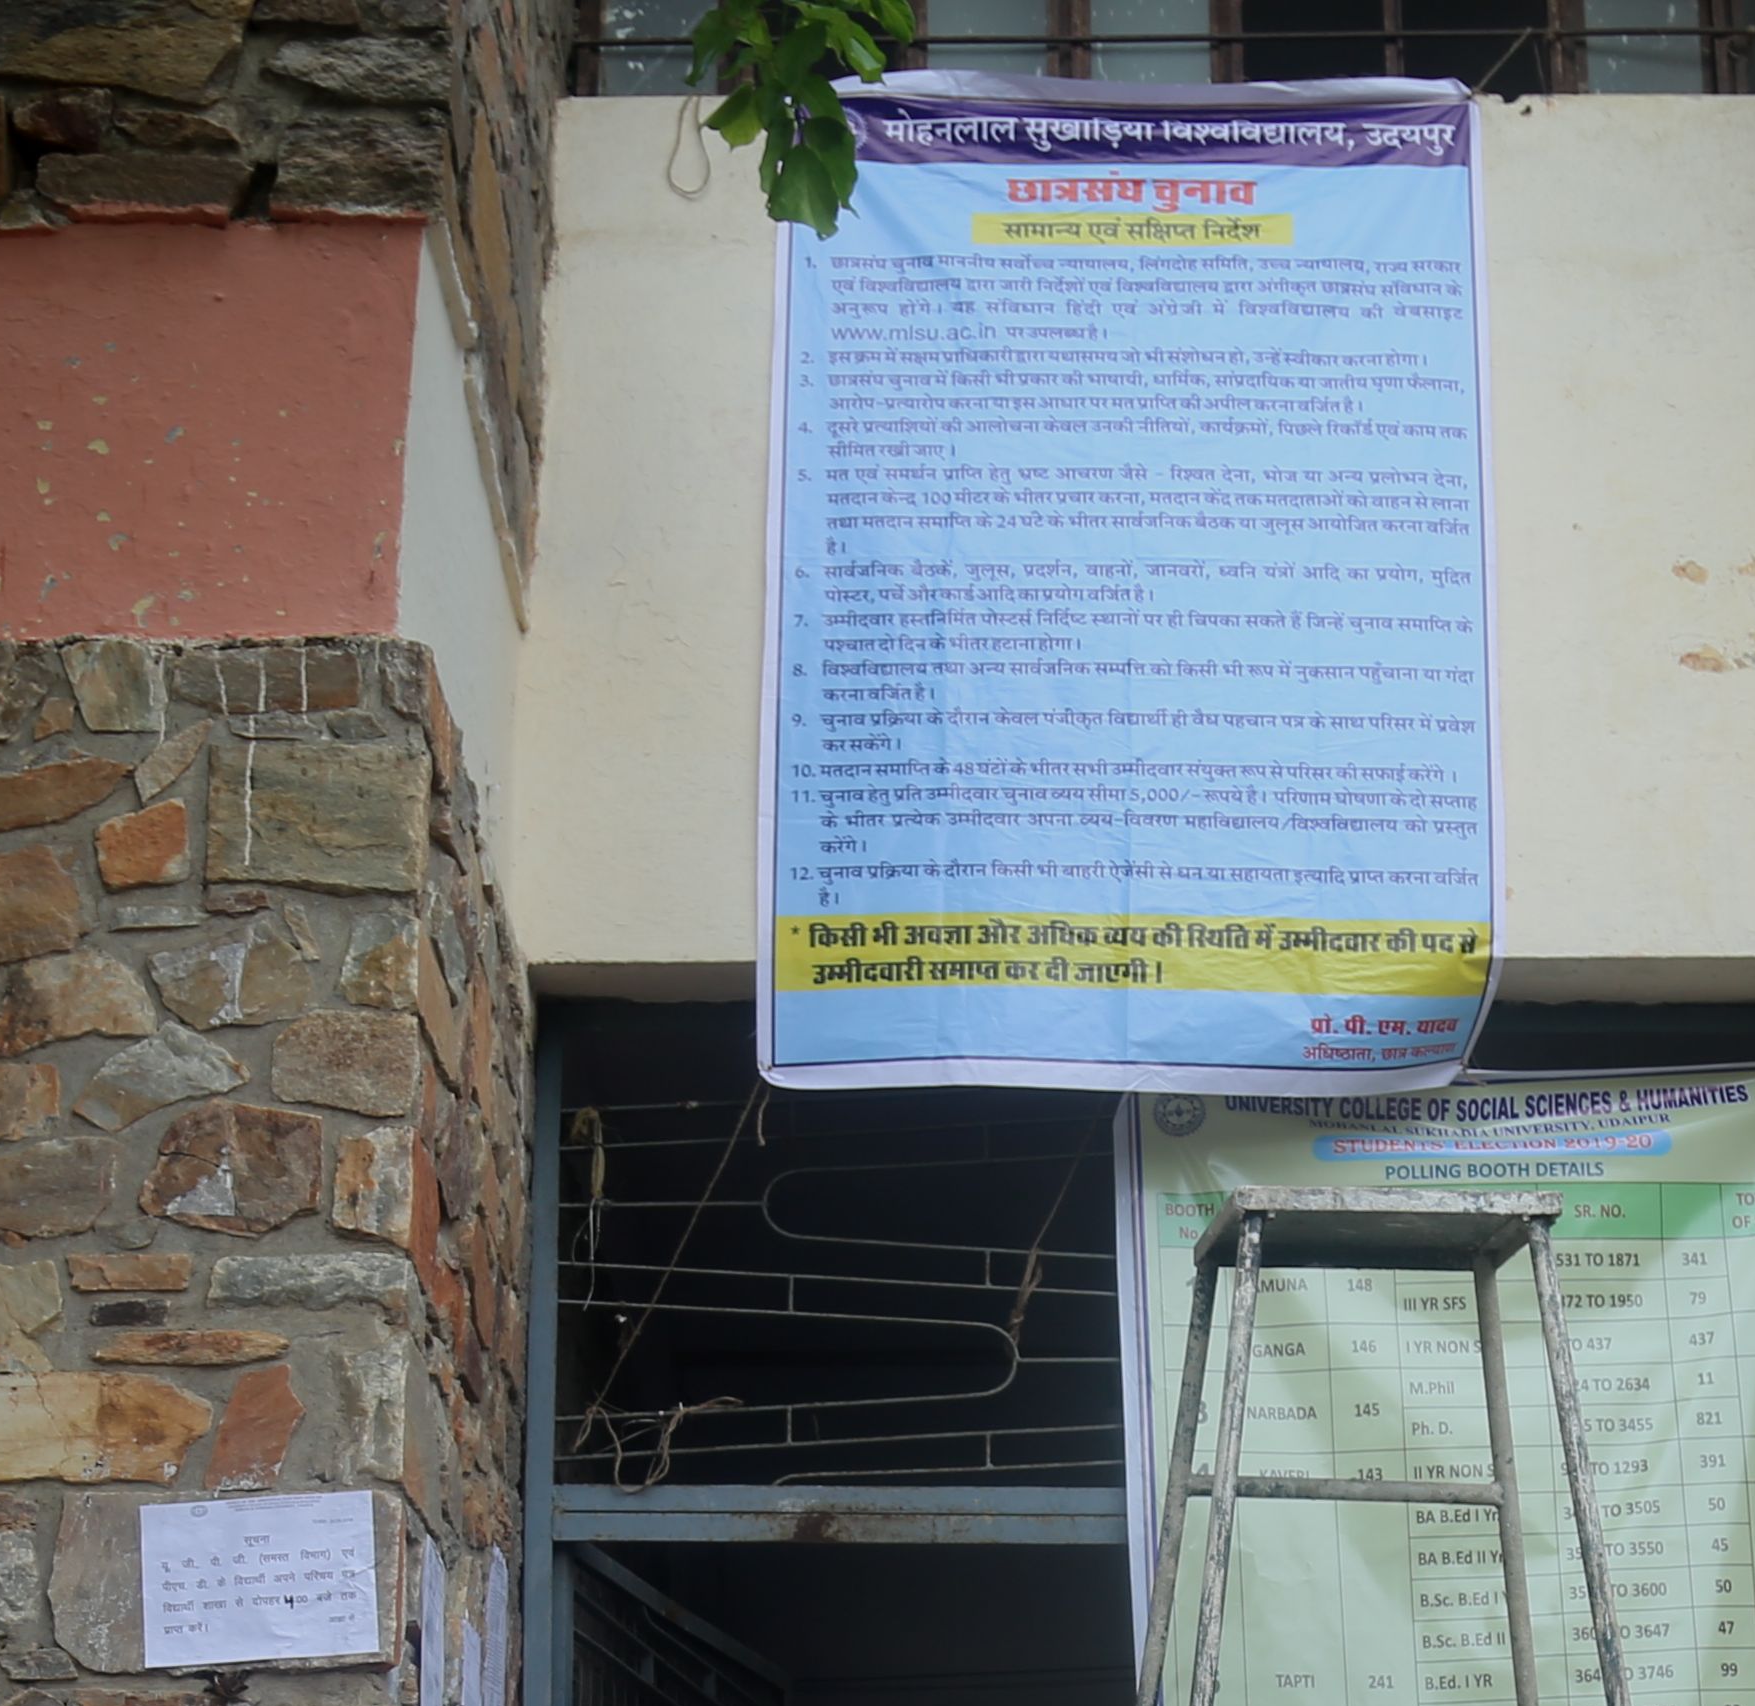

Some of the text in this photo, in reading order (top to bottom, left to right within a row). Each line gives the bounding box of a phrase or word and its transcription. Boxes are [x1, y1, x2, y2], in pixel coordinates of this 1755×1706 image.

[883, 109, 1019, 146] मोहनलाल
[1362, 123, 1456, 156] उदयपुर
[1006, 170, 1258, 213] छात्रसंघ चुनाव
[1003, 222, 1082, 239] सामान्य
[1085, 217, 1121, 243] एवं
[1204, 217, 1262, 240] निर्देश
[832, 324, 996, 341] www.mlsu.ac.in
[809, 922, 868, 948] किसी
[872, 921, 898, 946] भी
[977, 919, 1024, 946] और
[1026, 920, 1097, 947] अधिक
[1103, 925, 1148, 947] व्यय
[1152, 923, 1186, 948] की
[1187, 922, 1249, 950] स्थिति
[1254, 923, 1277, 951] में
[1278, 926, 1381, 952] उम्मीदवार
[1386, 927, 1420, 953] की
[1421, 932, 1454, 954] पद
[1458, 927, 1478, 954] से
[812, 956, 925, 985] उम्मीदवारी
[929, 960, 999, 982] समाप्त
[1004, 961, 1040, 982] कर
[1045, 957, 1069, 983] दी
[1310, 1013, 1460, 1036] प्रो. पी. एम. यादव
[1225, 1083, 1750, 1123] UNIVERSITY COLLEGE OF SOCIAL SCIENCES & HUMANITIES
[1498, 1119, 1594, 1138] UNIVERSITY,
[1598, 1113, 1671, 1130] UDAIPUR
[1564, 1133, 1652, 1150] 2019-20
[1385, 1161, 1605, 1180] POLLING BOOTH DETAILS
[1166, 1203, 1215, 1217] BOOTH
[1574, 1203, 1626, 1219] SR. NO.
[1732, 1215, 1750, 1229] OF
[1347, 1278, 1373, 1292] 148
[1403, 1296, 1467, 1312] III YR SFS
[1252, 1342, 1306, 1358] GANGA
[1351, 1339, 1377, 1354] 146
[1409, 1381, 1455, 1396] M.Phil
[1246, 1406, 1317, 1421] NARBADA
[1354, 1403, 1381, 1418] 145
[1275, 1674, 1316, 1689] TAPTI
[1368, 1675, 1394, 1689] 241
